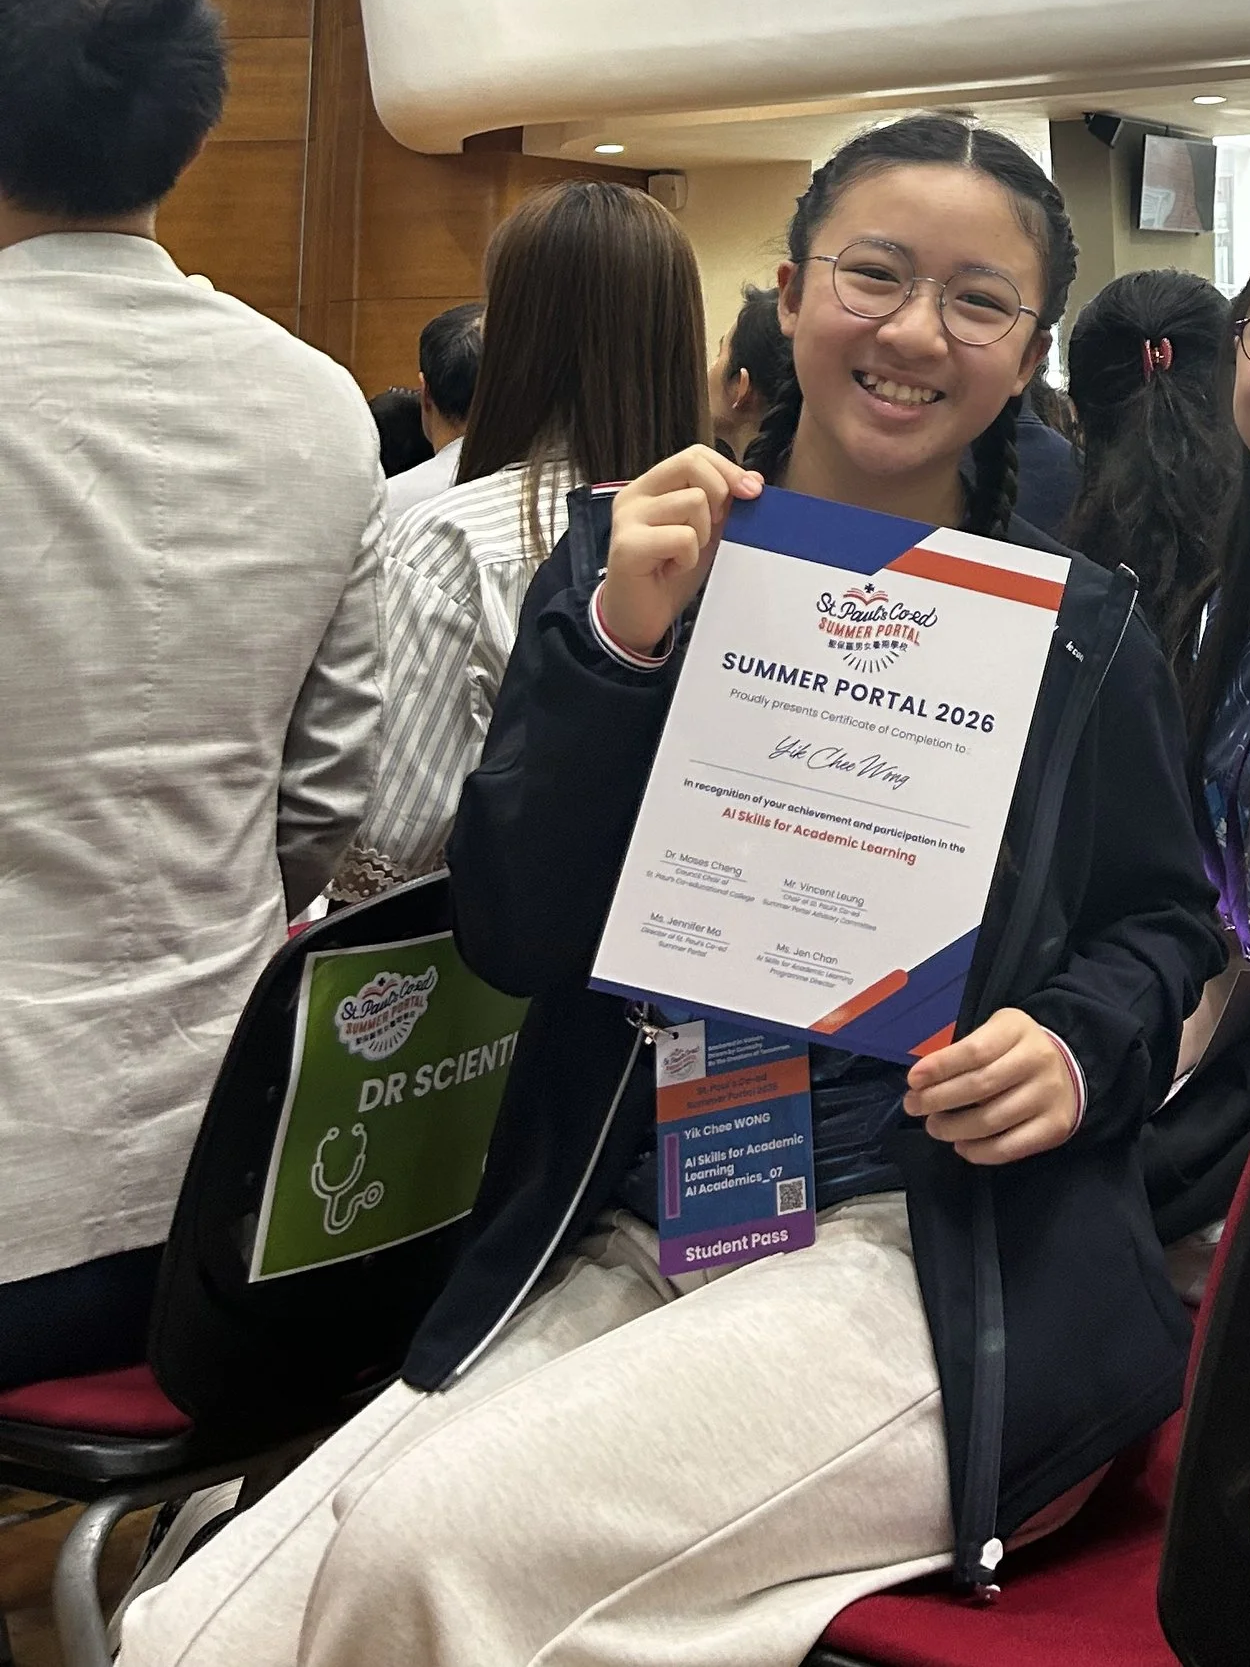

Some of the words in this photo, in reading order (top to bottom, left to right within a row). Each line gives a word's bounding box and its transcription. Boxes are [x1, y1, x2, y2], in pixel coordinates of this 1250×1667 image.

[838, 601, 888, 622] Paul's
[889, 602, 938, 628] Co-ed
[818, 616, 873, 639] SUMMER
[876, 623, 920, 646] PORTAL
[722, 652, 829, 693] SUMMER
[834, 678, 928, 717] PORTAL
[935, 702, 995, 733] 2026
[729, 688, 770, 708] Proudly
[772, 700, 818, 718] presents
[820, 710, 876, 732] Certificate
[878, 724, 889, 735] of
[891, 727, 953, 752] Completion
[769, 735, 807, 761] Yik
[806, 746, 855, 772] Chee
[857, 754, 911, 790] Wong
[684, 778, 694, 788] In
[695, 782, 751, 802] recognition
[752, 795, 763, 805] of
[763, 798, 787, 810] your
[787, 803, 852, 827] achievement
[853, 818, 872, 831] and
[873, 823, 938, 845] participation
[938, 838, 948, 849] in
[949, 841, 965, 854] the
[721, 807, 736, 819] AI
[738, 810, 771, 828] Skills
[774, 818, 792, 833] for
[794, 825, 859, 849] Academic
[860, 840, 917, 865] Learning
[680, 853, 709, 867] Moses
[711, 860, 742, 877] Cheng
[800, 882, 836, 897] Vincent
[837, 891, 865, 907] Leung
[667, 917, 706, 932] Jennifer
[706, 926, 721, 937] Ma
[793, 947, 810, 958] Jen
[812, 952, 838, 965] Chan
[345, 1011, 390, 1034] SUMMER
[391, 995, 424, 1018] PORTAL
[360, 991, 398, 1018] Paul's
[357, 1072, 407, 1113] DR
[684, 1125, 701, 1140] Yik
[703, 1121, 733, 1137] Chee
[734, 1112, 771, 1130] WONG
[685, 1157, 697, 1169] AI
[698, 1149, 727, 1166] Skills
[728, 1145, 744, 1159] for
[746, 1133, 804, 1156] Academic
[685, 1164, 735, 1183] Learning
[685, 1185, 698, 1198] AI
[699, 1166, 783, 1194] Academics_07
[686, 1235, 749, 1261] Student
[751, 1228, 789, 1248] Pass
